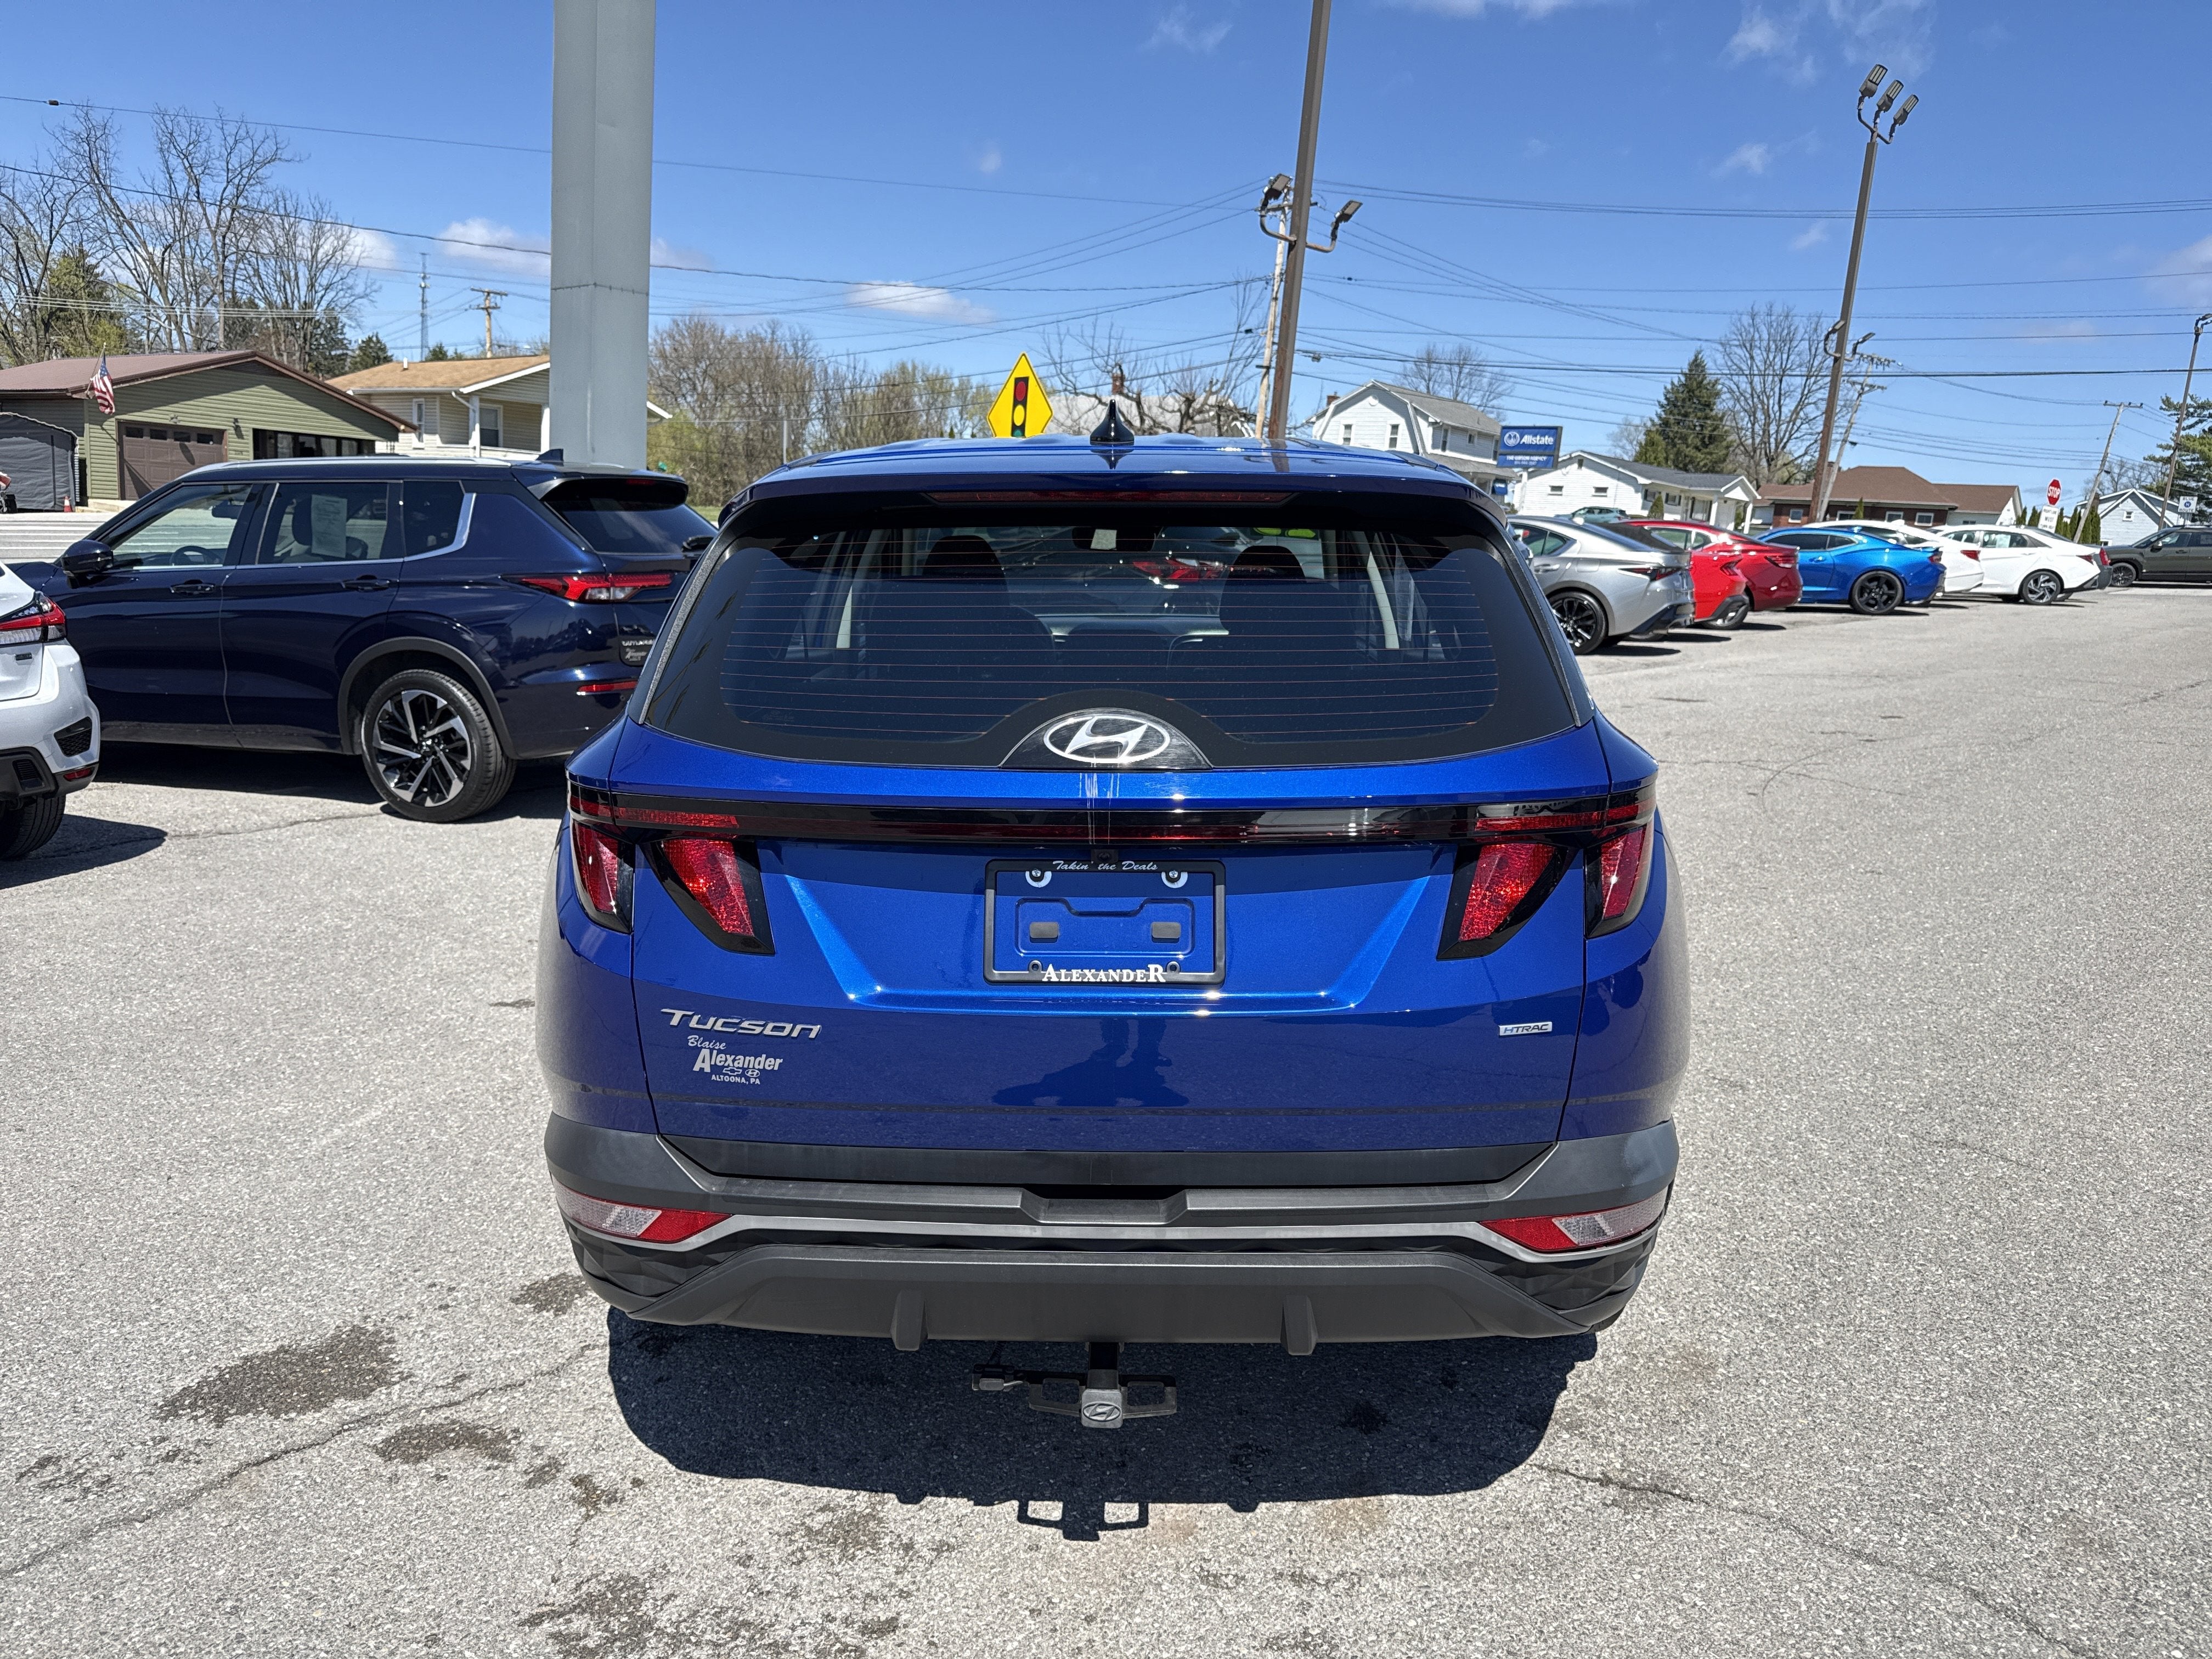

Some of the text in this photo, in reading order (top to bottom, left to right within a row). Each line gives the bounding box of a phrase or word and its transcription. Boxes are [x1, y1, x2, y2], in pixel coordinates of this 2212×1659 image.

[1520, 434, 1554, 445] Allstate
[2047, 486, 2061, 499] STOP
[1052, 860, 1159, 871] Takin' the Deals
[1042, 963, 1166, 983] ALEXANDER
[1503, 1024, 1549, 1034] HTRAC
[687, 1035, 727, 1049] Blaise
[692, 1048, 783, 1073] Alexander
[711, 1074, 748, 1085] ALTOONA,
